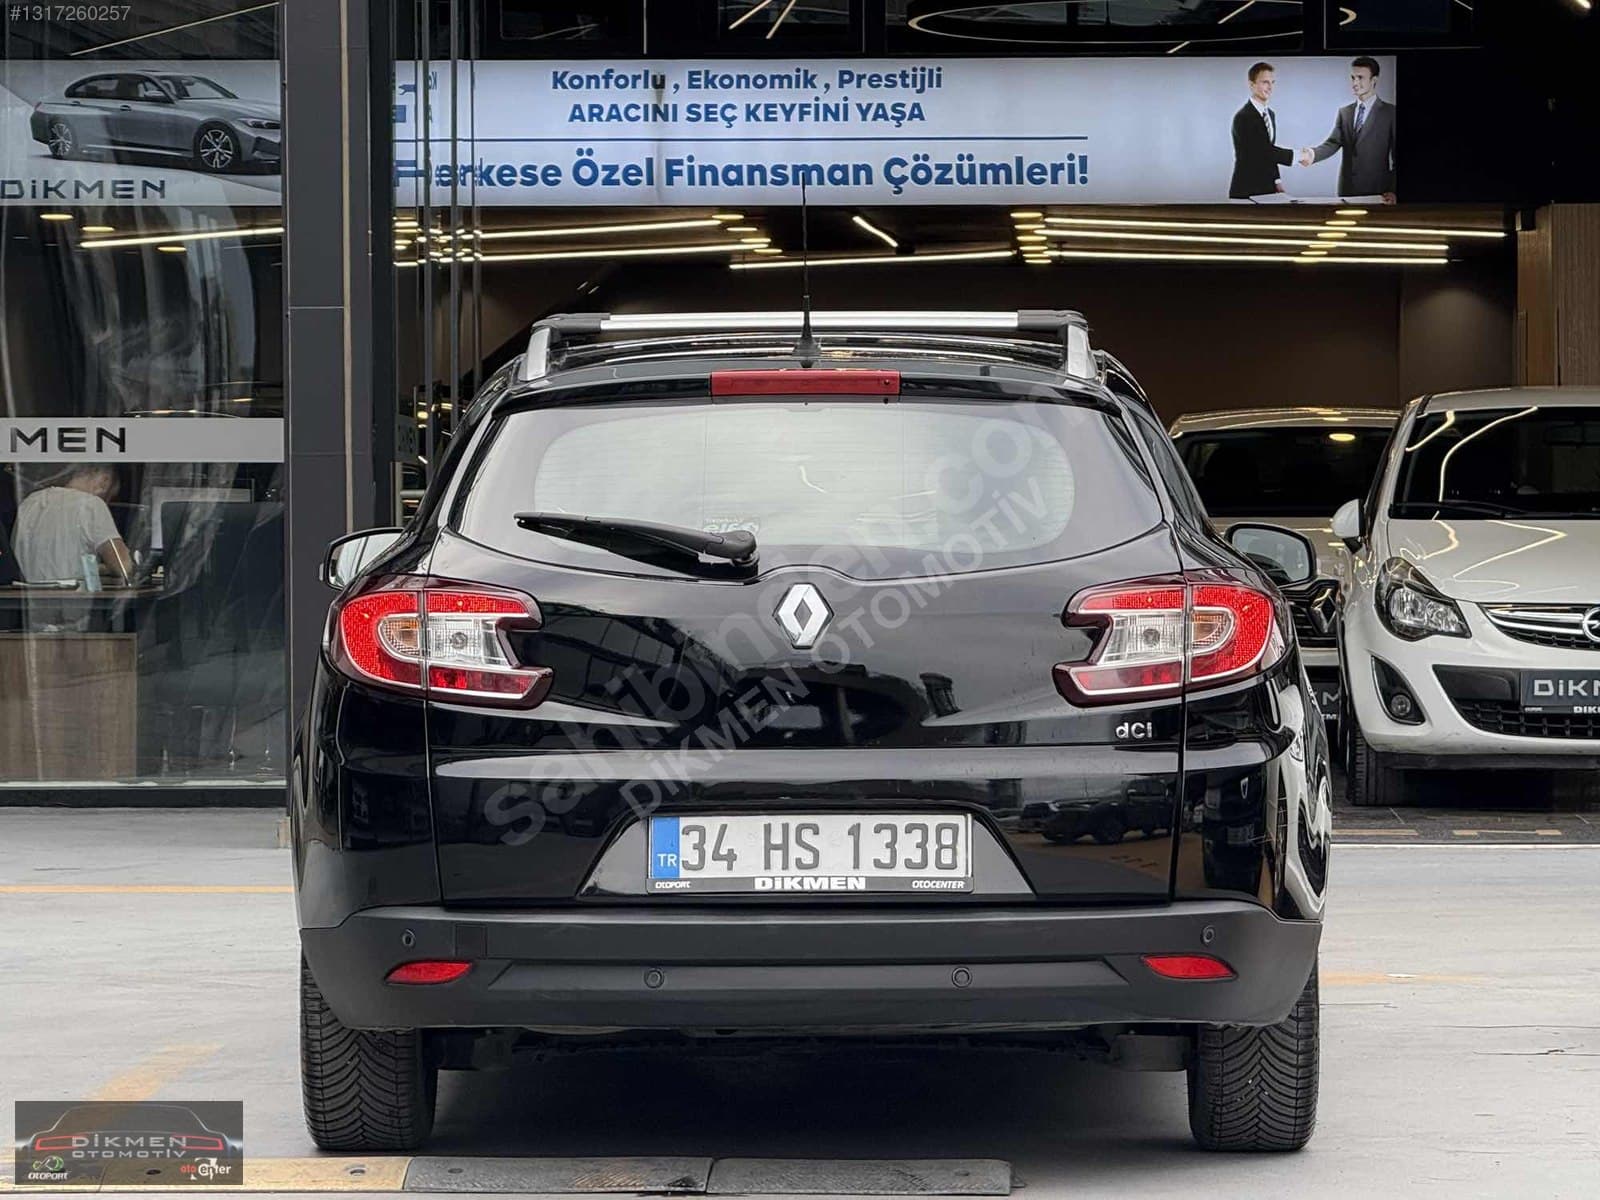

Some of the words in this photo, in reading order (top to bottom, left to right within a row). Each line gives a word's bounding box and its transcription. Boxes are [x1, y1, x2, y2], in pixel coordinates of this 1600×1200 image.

[552, 70, 666, 90] Konforlu
[687, 67, 818, 90] Ekonomik
[838, 67, 943, 94] Prestijli
[568, 103, 678, 123] ARACINI
[685, 103, 737, 128] SEÇ
[744, 97, 849, 122] KEYFİNİ
[855, 102, 926, 128] YAŞA
[572, 147, 654, 187] Özel
[665, 154, 873, 187] Finansman
[883, 152, 1089, 195] Çözümleri!
[657, 853, 677, 867] TR
[681, 823, 737, 872] 34
[763, 822, 820, 870] HS
[848, 822, 959, 870] 1338
